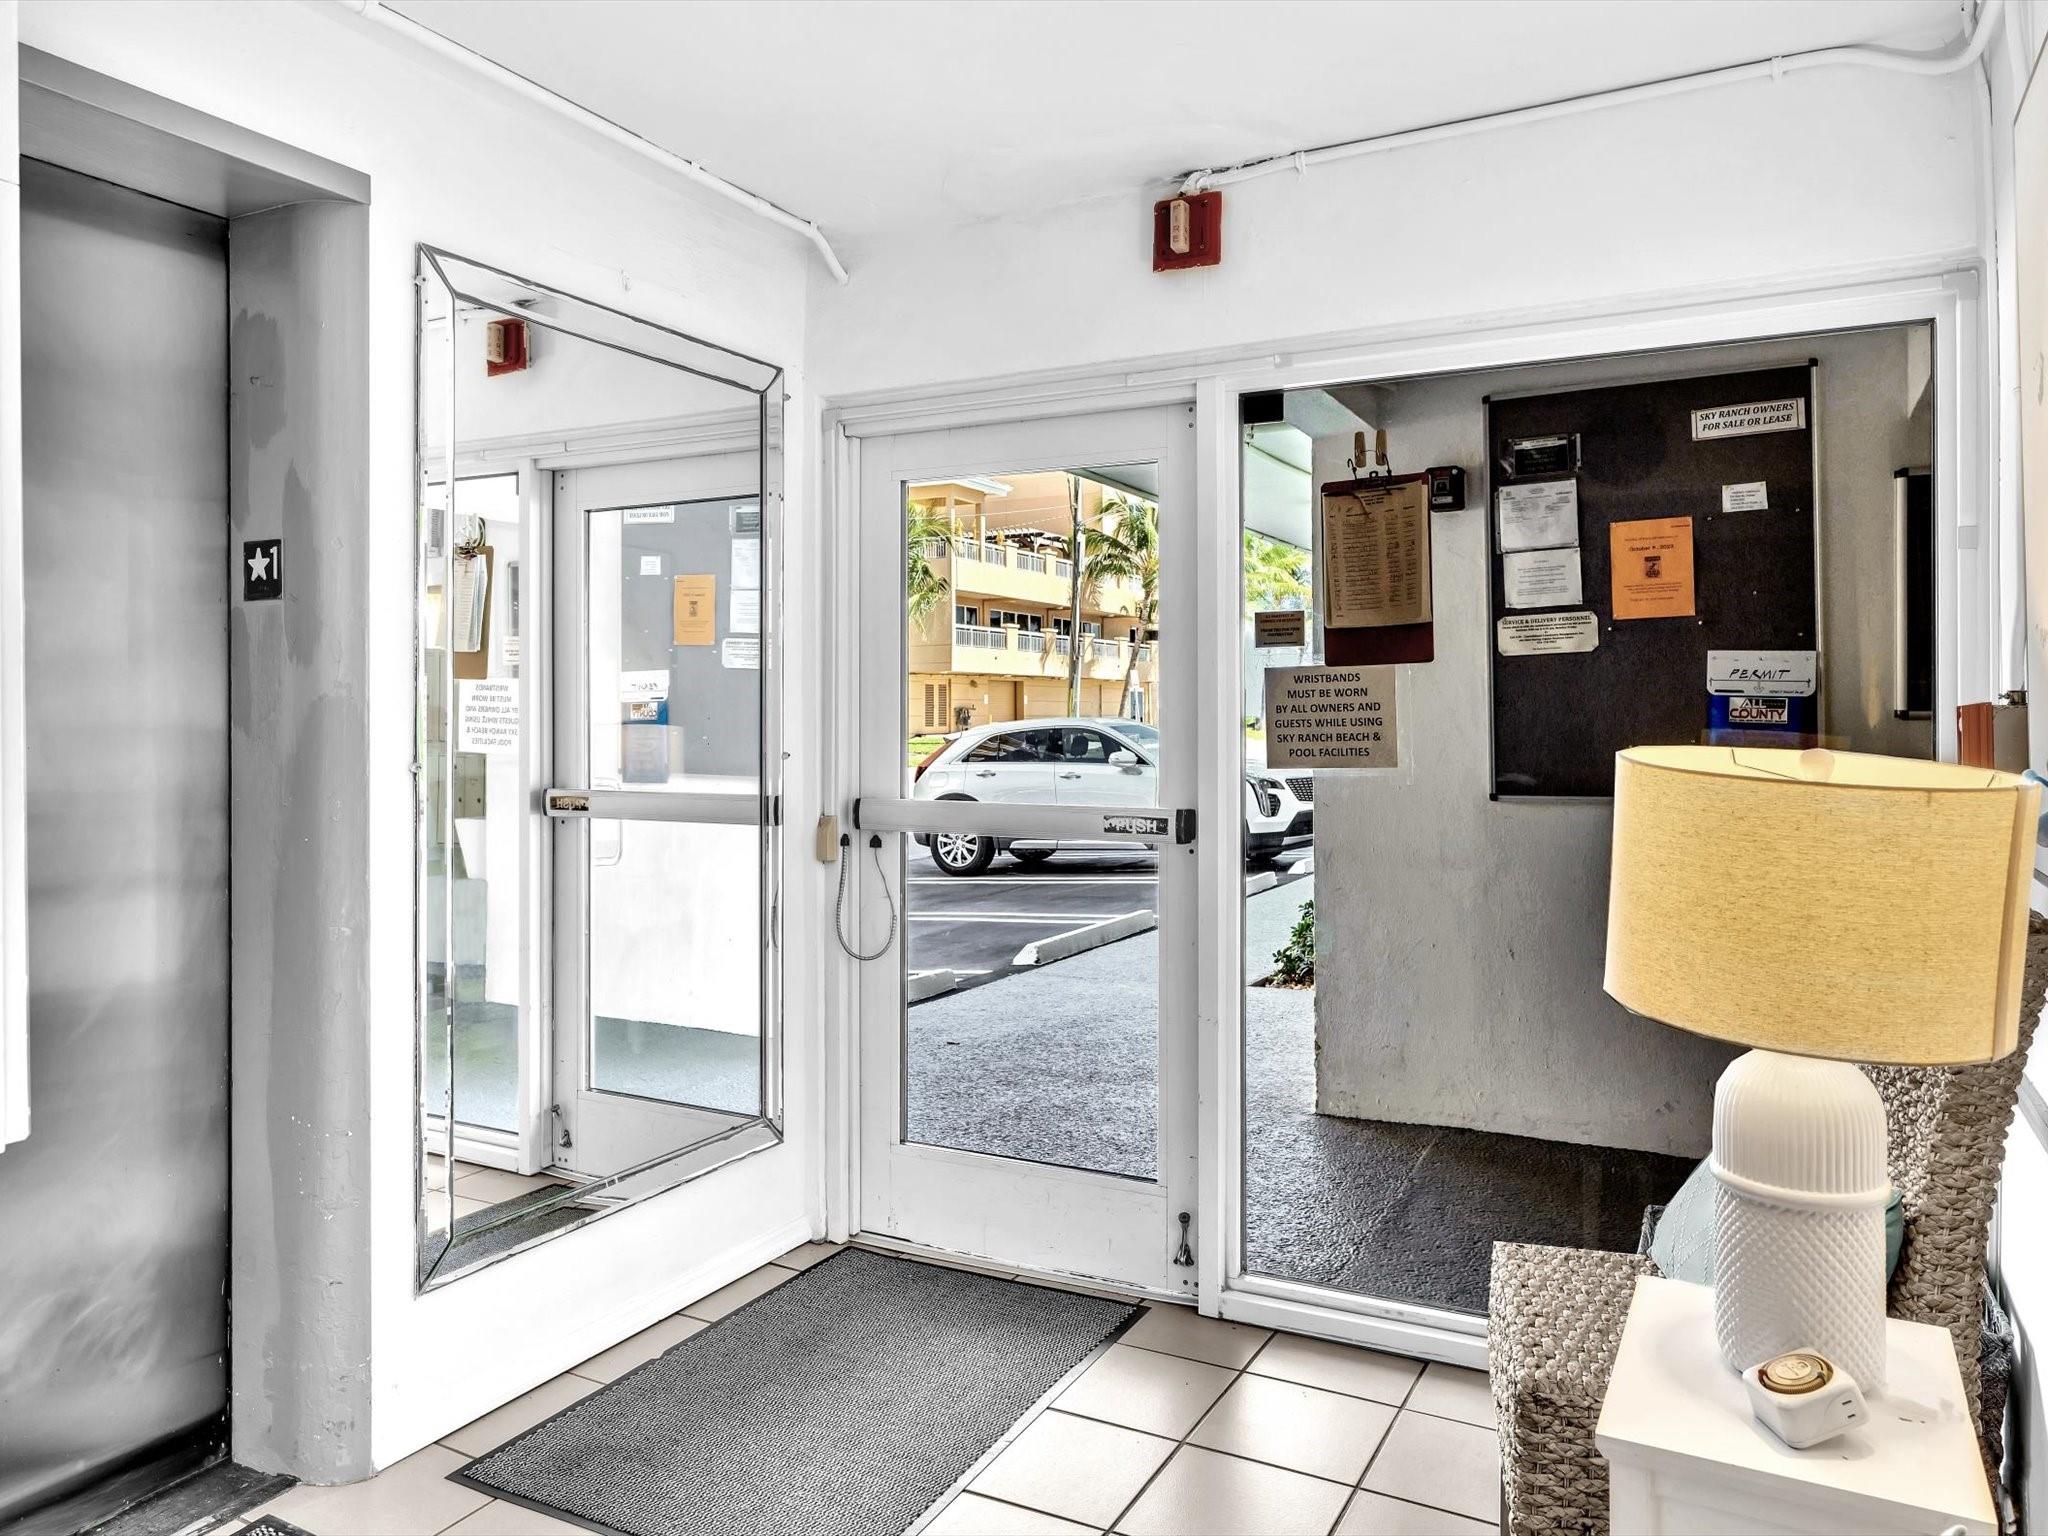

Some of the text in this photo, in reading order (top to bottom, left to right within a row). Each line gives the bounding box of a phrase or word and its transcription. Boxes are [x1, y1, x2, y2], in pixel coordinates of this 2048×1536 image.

[1699, 403, 1794, 421] SKY RANCH OWNERS
[1702, 414, 1792, 432] FOR SALE OR LEASE
[270, 546, 278, 580] 1
[1293, 673, 1361, 684] WRISTBANDS
[1729, 668, 1791, 680] PERMIT
[1287, 687, 1368, 699] MUST BE WORN
[1276, 702, 1381, 714] BY ALL OWNERS AND
[1740, 698, 1766, 708] ALL
[1729, 708, 1785, 720] COUNTY
[1275, 717, 1383, 729] GUESTS WHILE USING
[1277, 732, 1381, 743] SKY RANCH BEACH &
[1289, 747, 1370, 758] POOL FACILITIES
